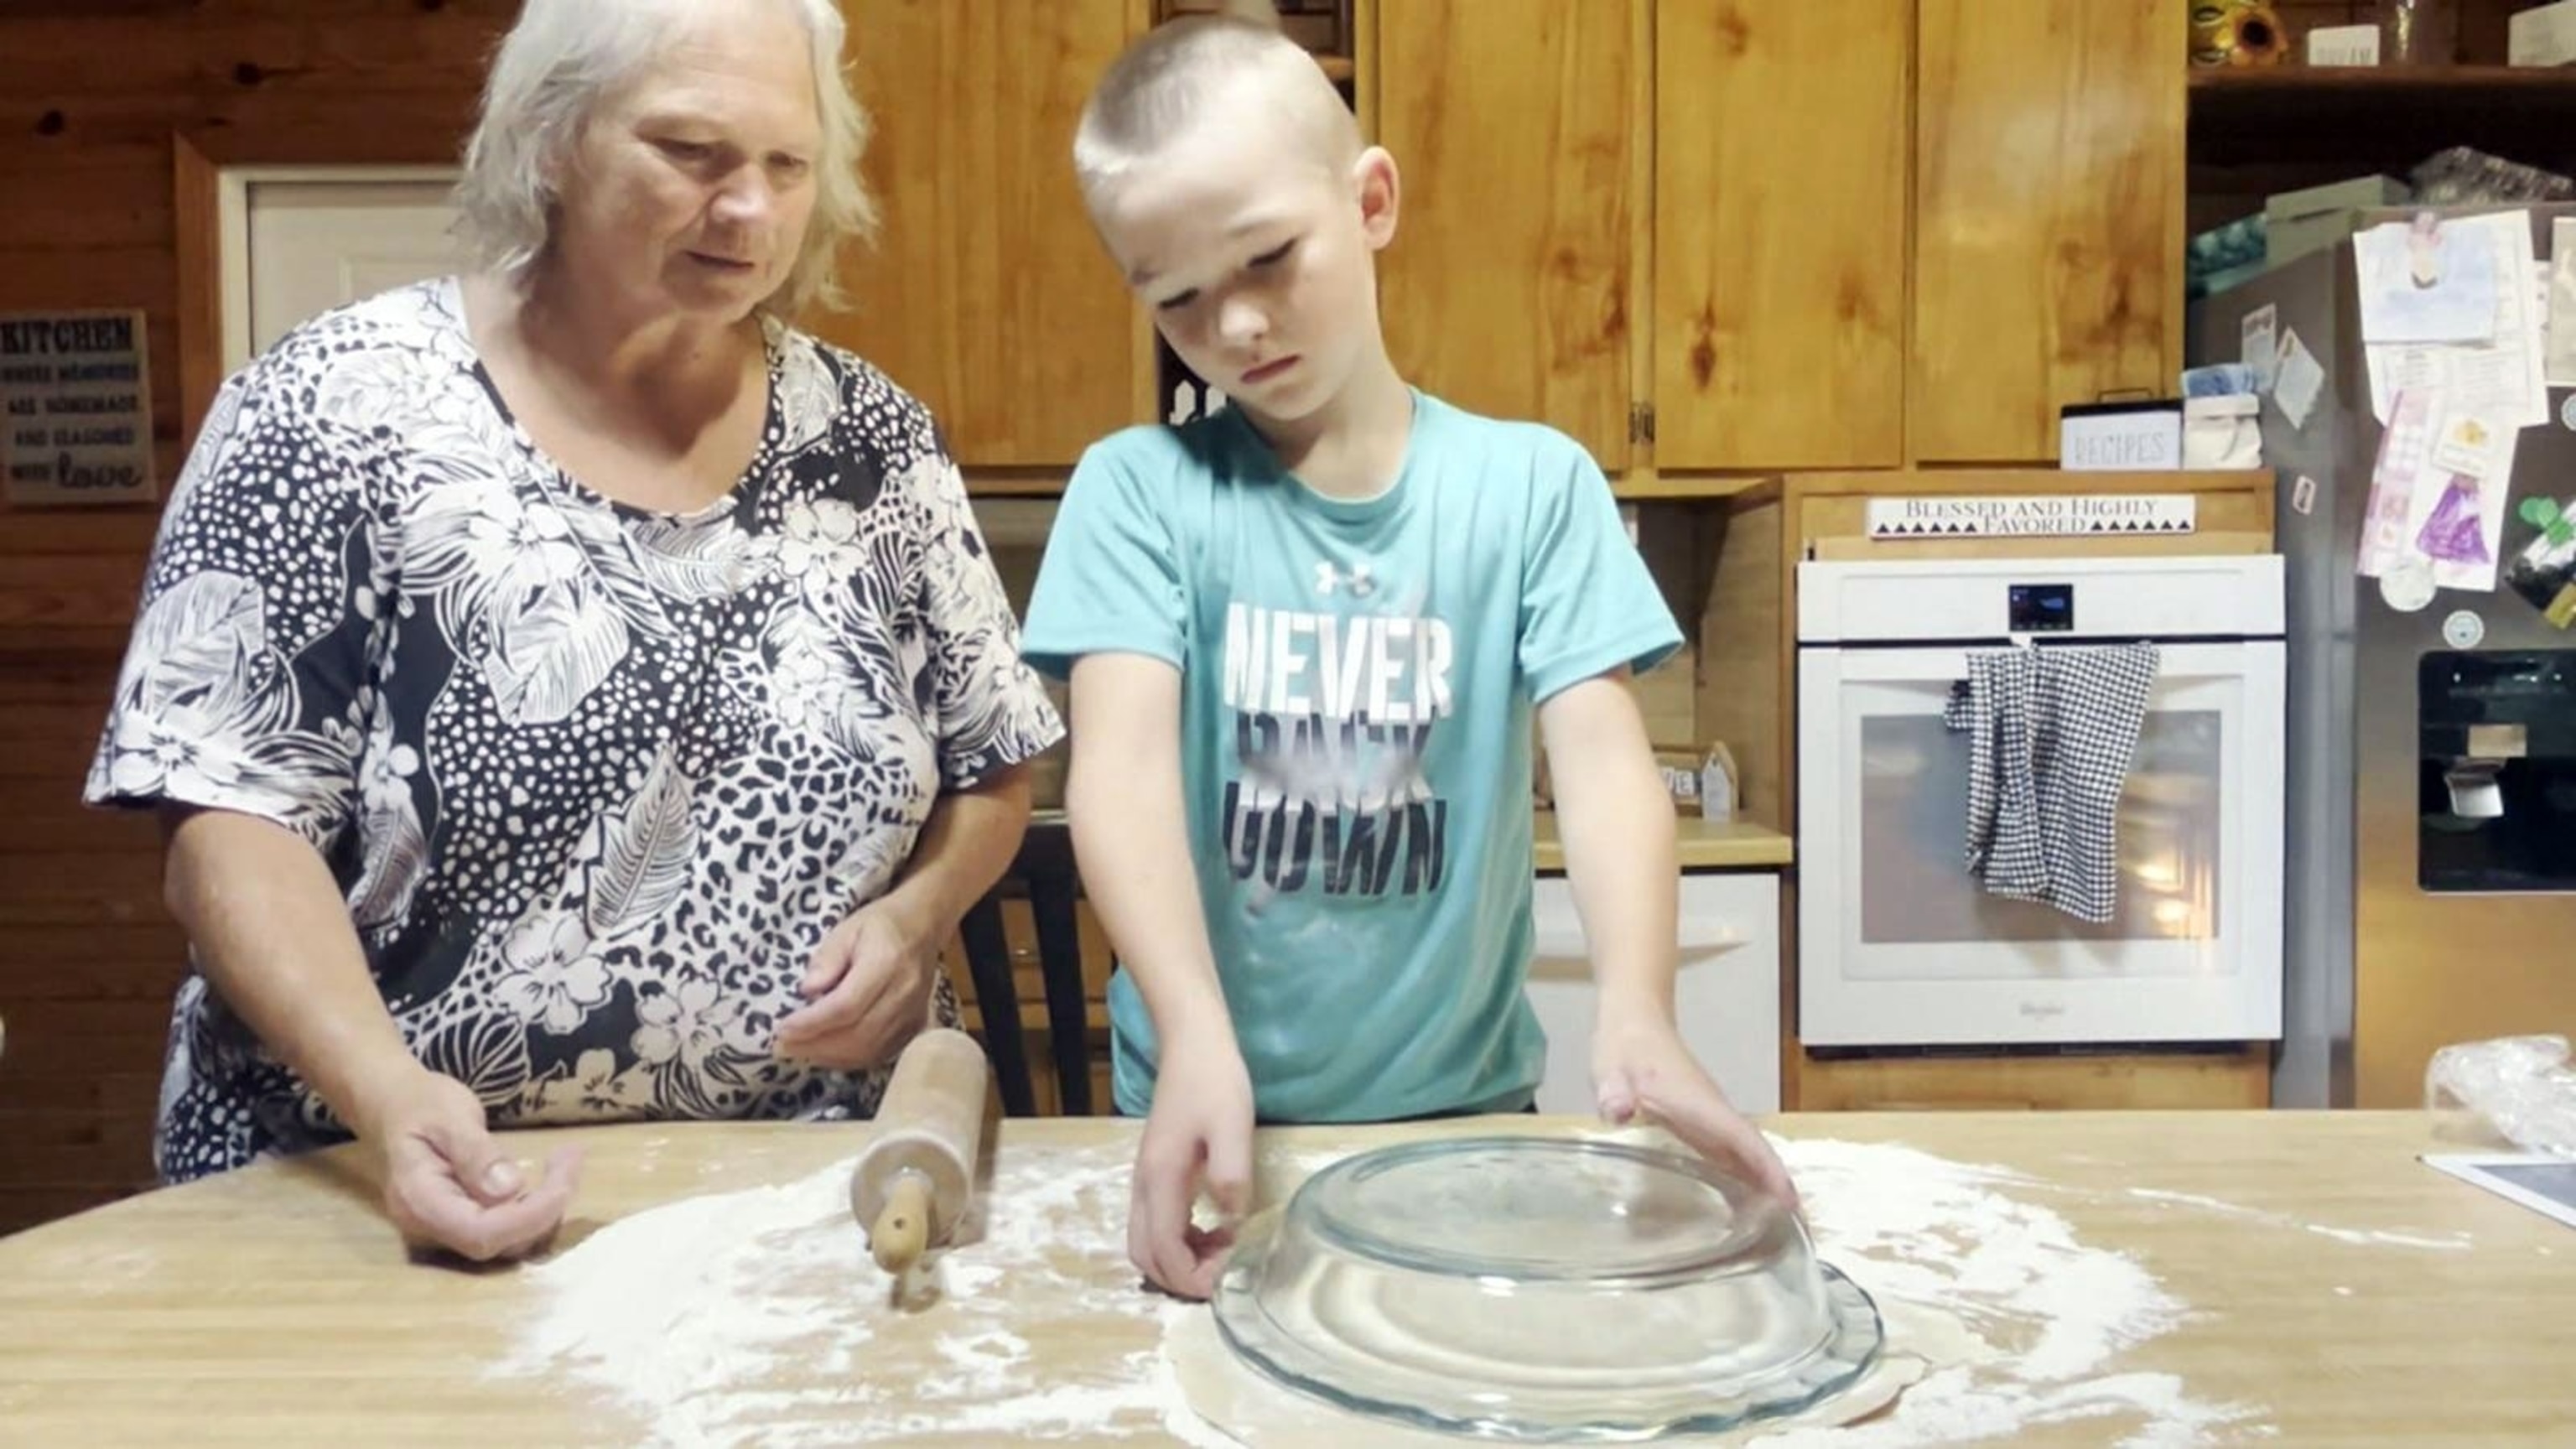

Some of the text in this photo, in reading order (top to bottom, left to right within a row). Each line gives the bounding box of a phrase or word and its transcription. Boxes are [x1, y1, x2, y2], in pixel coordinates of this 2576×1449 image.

[0, 319, 132, 353] KITCHEN
[2075, 432, 2164, 463] RECIPES
[57, 451, 142, 488] love
[1907, 498, 2157, 517] BLESSED AND HIGHLY
[1984, 515, 2086, 532] FAVORED
[1223, 603, 1452, 722] NEVER
[1223, 782, 1447, 896] DOWN
